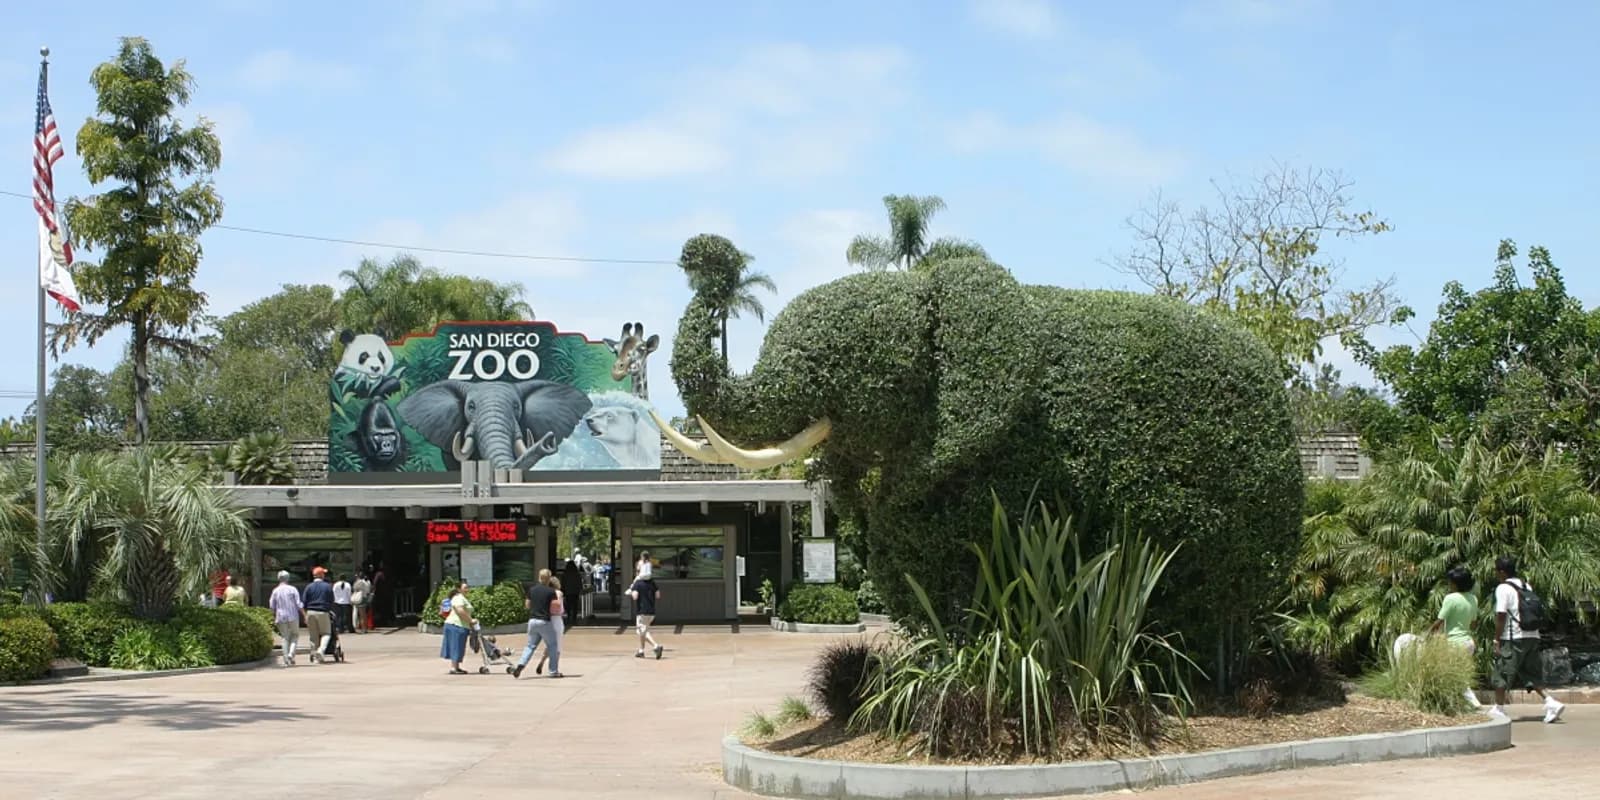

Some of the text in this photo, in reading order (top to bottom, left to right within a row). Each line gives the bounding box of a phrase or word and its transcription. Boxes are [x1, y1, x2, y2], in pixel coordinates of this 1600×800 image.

[449, 332, 540, 348] SAN DIEGO
[447, 349, 540, 380] ZOO
[427, 521, 517, 533] Panda Viewing
[427, 531, 449, 542] 9am
